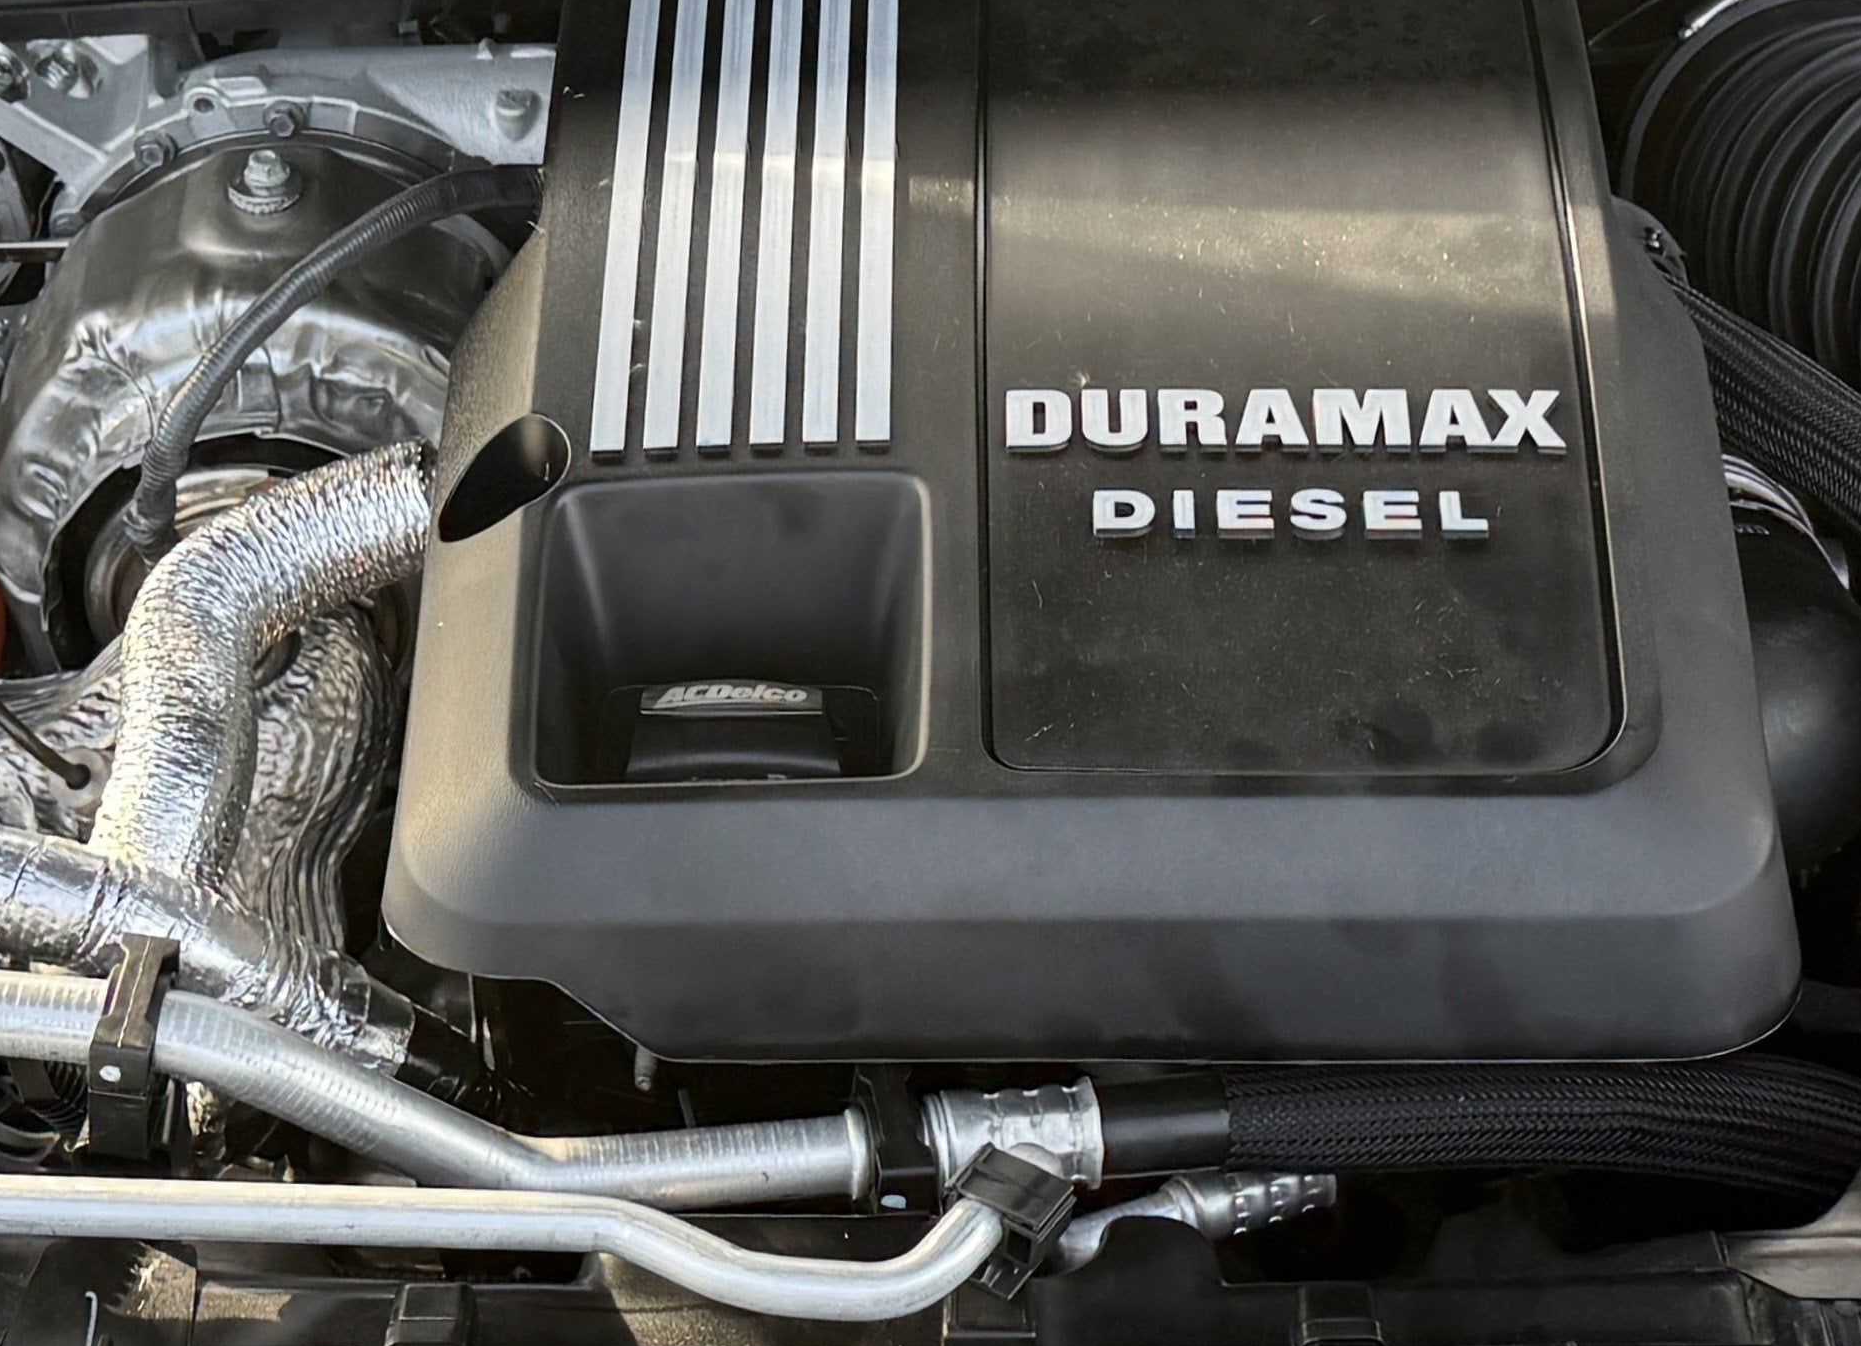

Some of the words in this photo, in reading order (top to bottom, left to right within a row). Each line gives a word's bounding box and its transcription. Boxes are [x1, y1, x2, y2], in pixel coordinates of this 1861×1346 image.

[1005, 388, 1566, 453] DURAMAX
[1092, 488, 1489, 539] DIESEL
[653, 683, 808, 709] ACDelco
